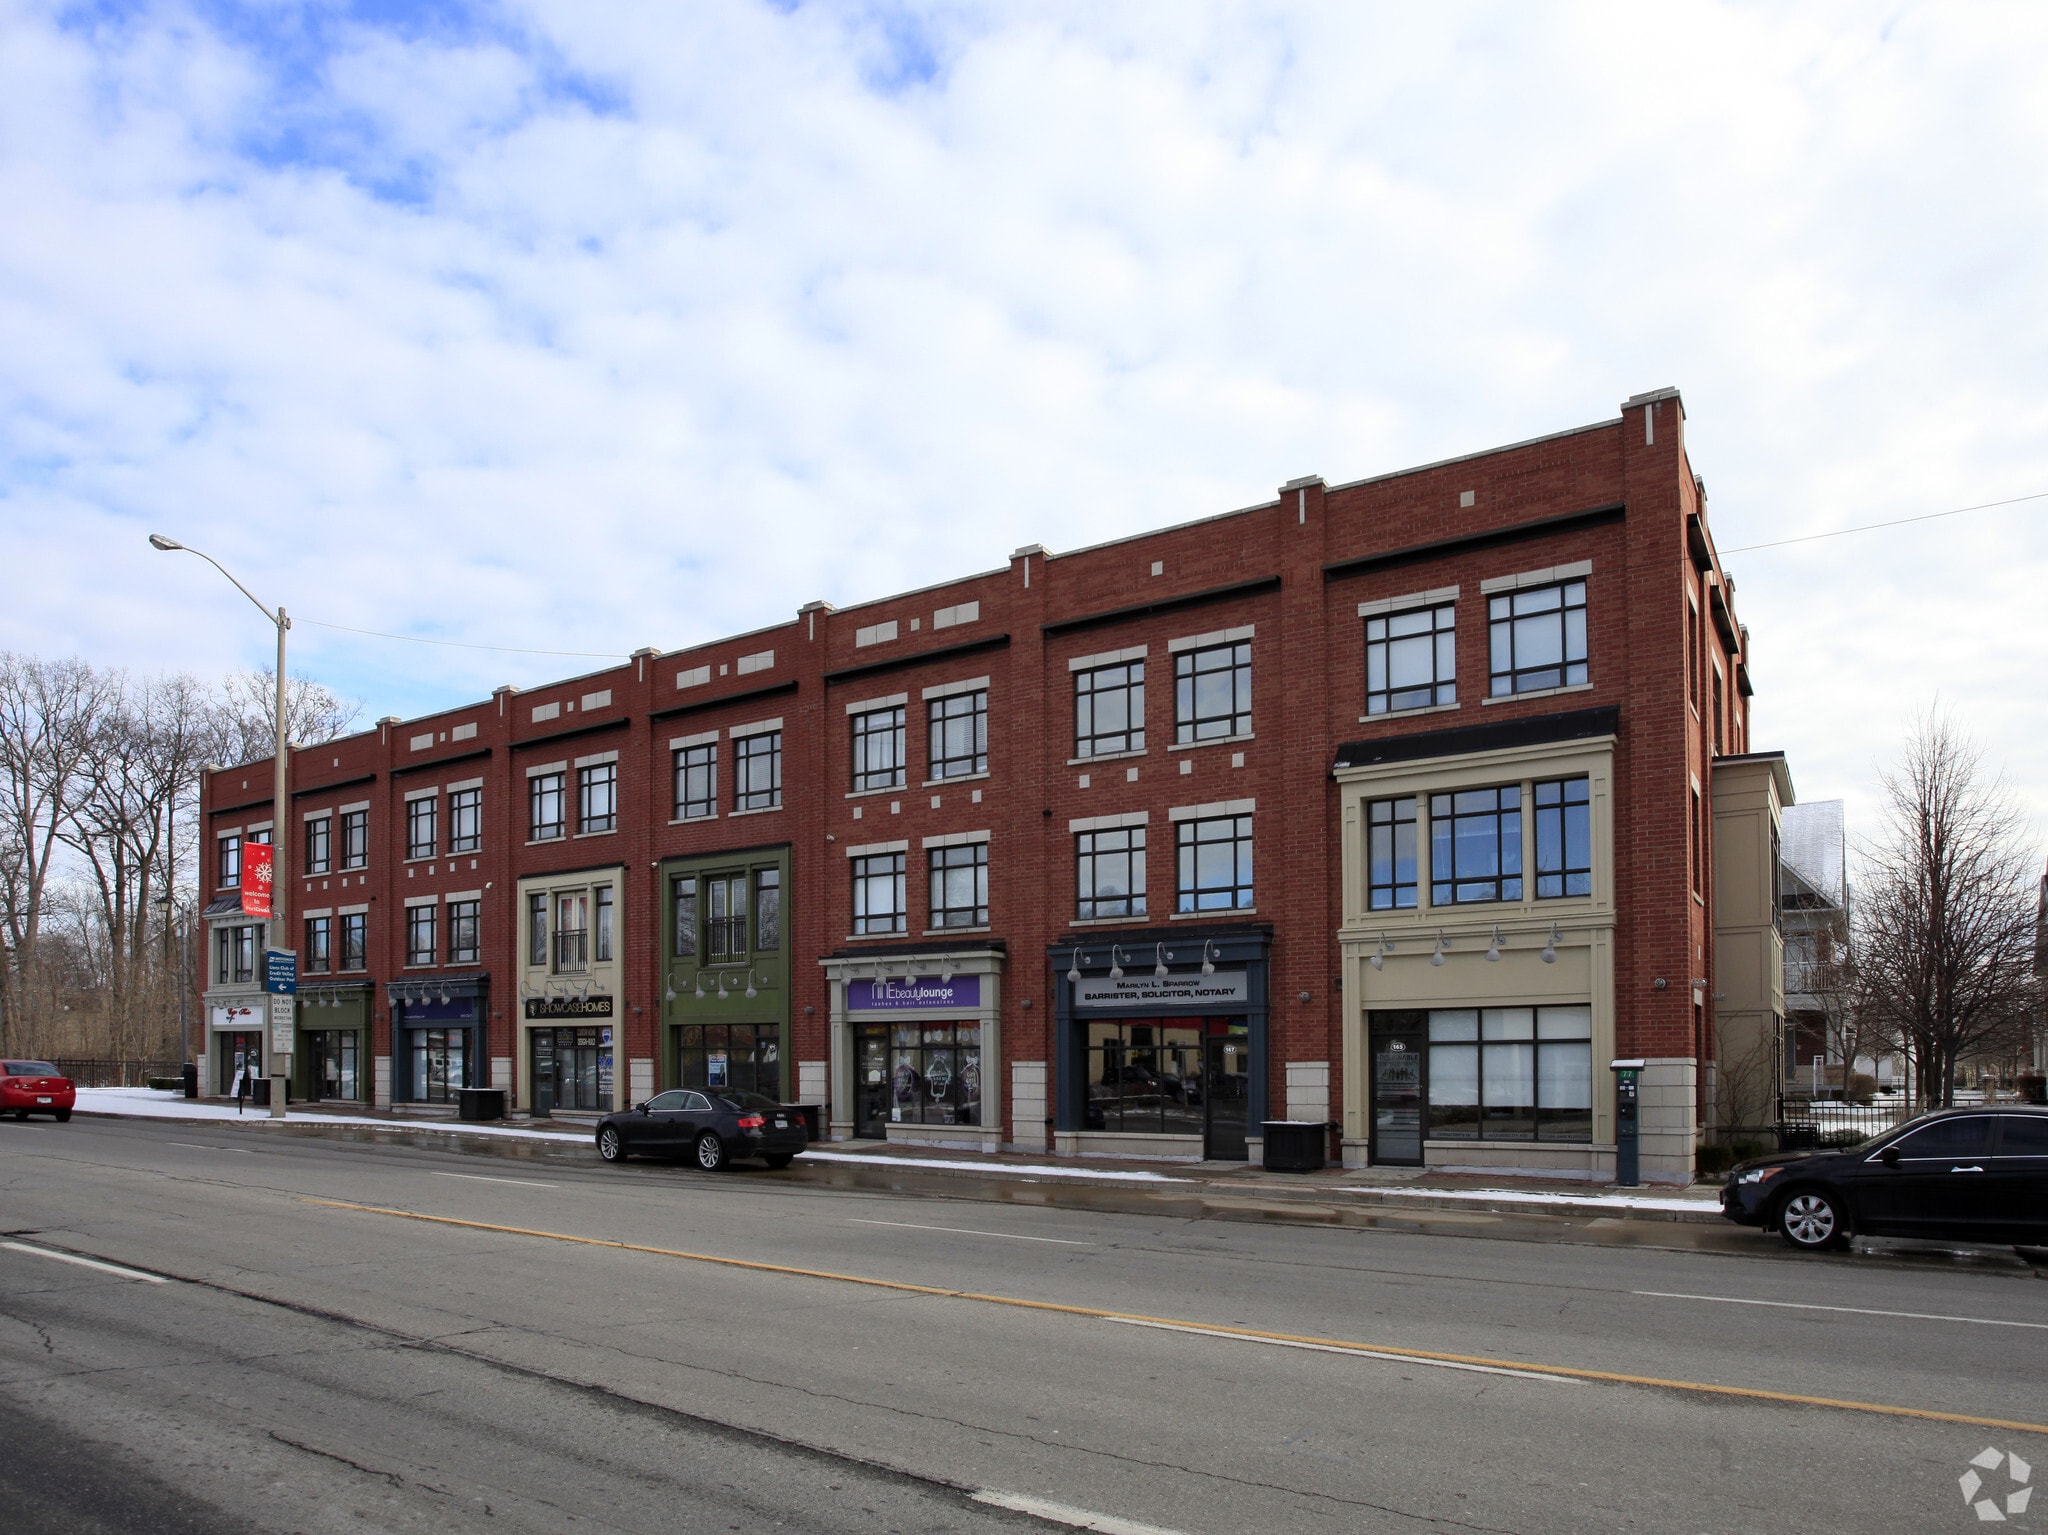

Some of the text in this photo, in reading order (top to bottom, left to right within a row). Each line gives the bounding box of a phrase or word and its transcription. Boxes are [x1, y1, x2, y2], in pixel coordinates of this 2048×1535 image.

[1084, 988, 1236, 1000] BARRISTER, SOLICITOR, NOTARY
